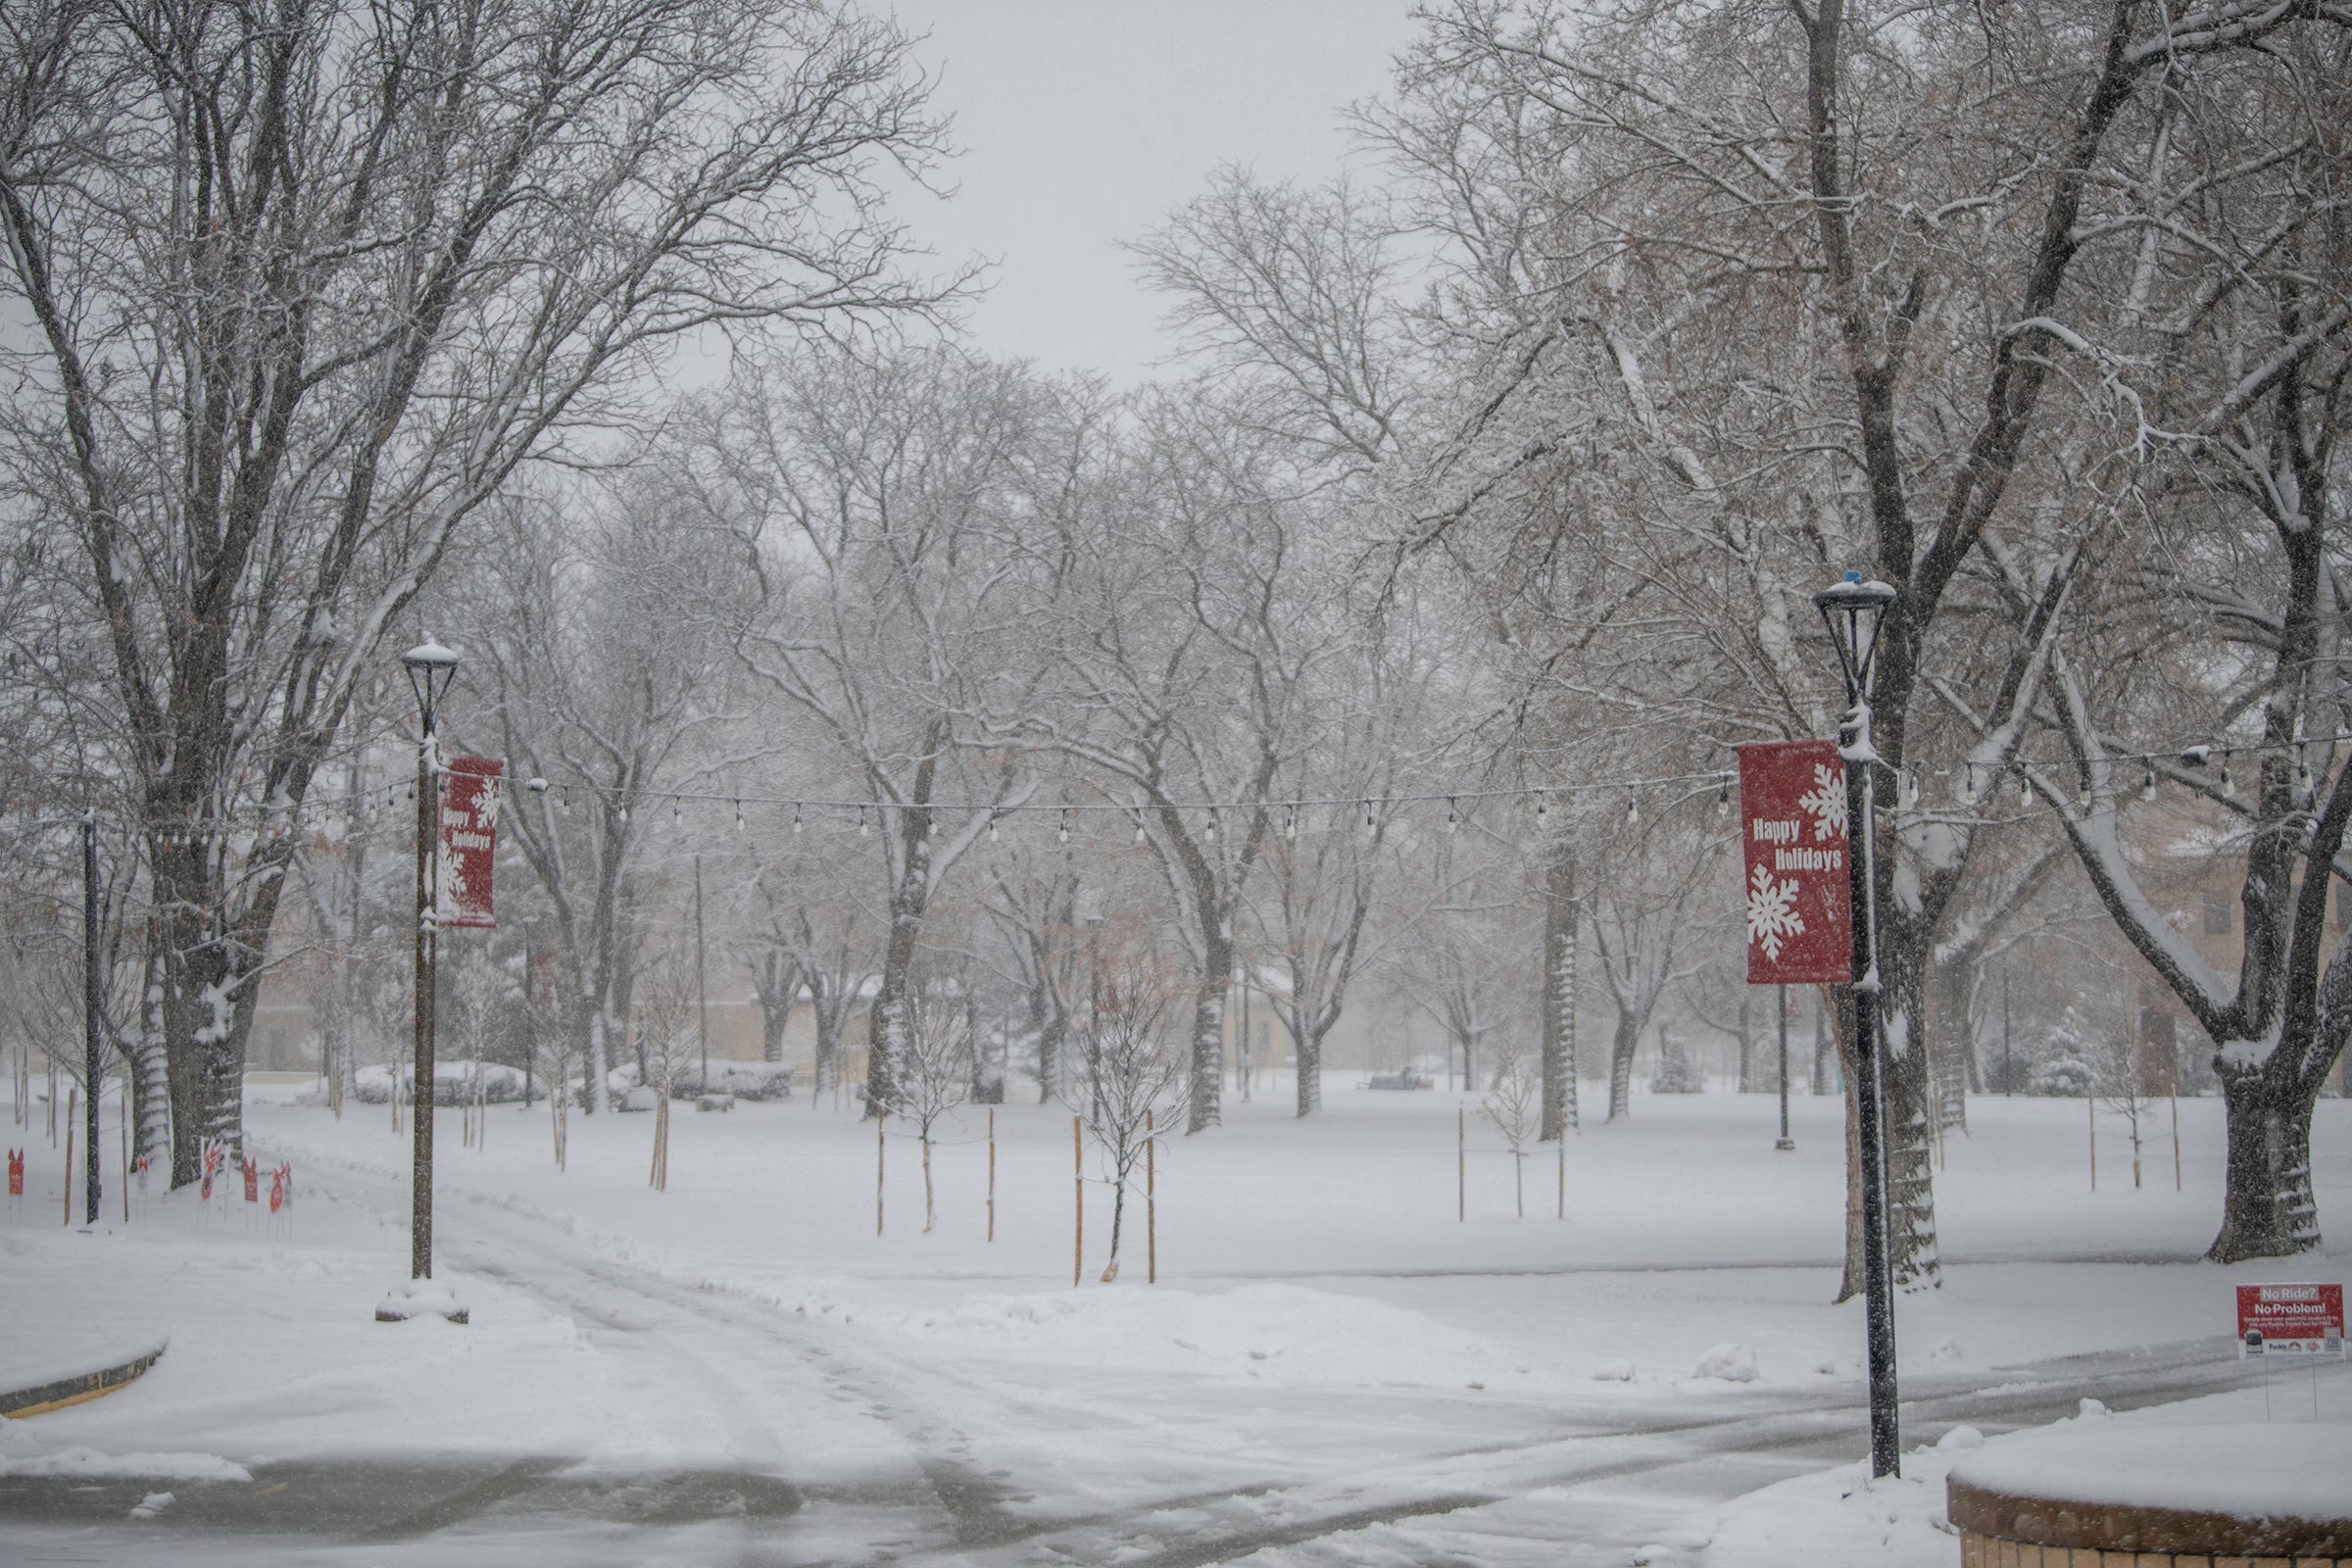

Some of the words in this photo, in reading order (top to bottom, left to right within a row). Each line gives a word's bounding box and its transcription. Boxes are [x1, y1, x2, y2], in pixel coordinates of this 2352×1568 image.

[443, 807, 470, 829] Happy
[452, 830, 491, 851] Holidays
[1753, 817, 1801, 844] Happy
[1775, 847, 1842, 872] Holidays
[2262, 1288, 2279, 1298] No
[2281, 1287, 2317, 1298] Ride?
[2254, 1304, 2272, 1314] No
[2273, 1302, 2327, 1314] Problem!
